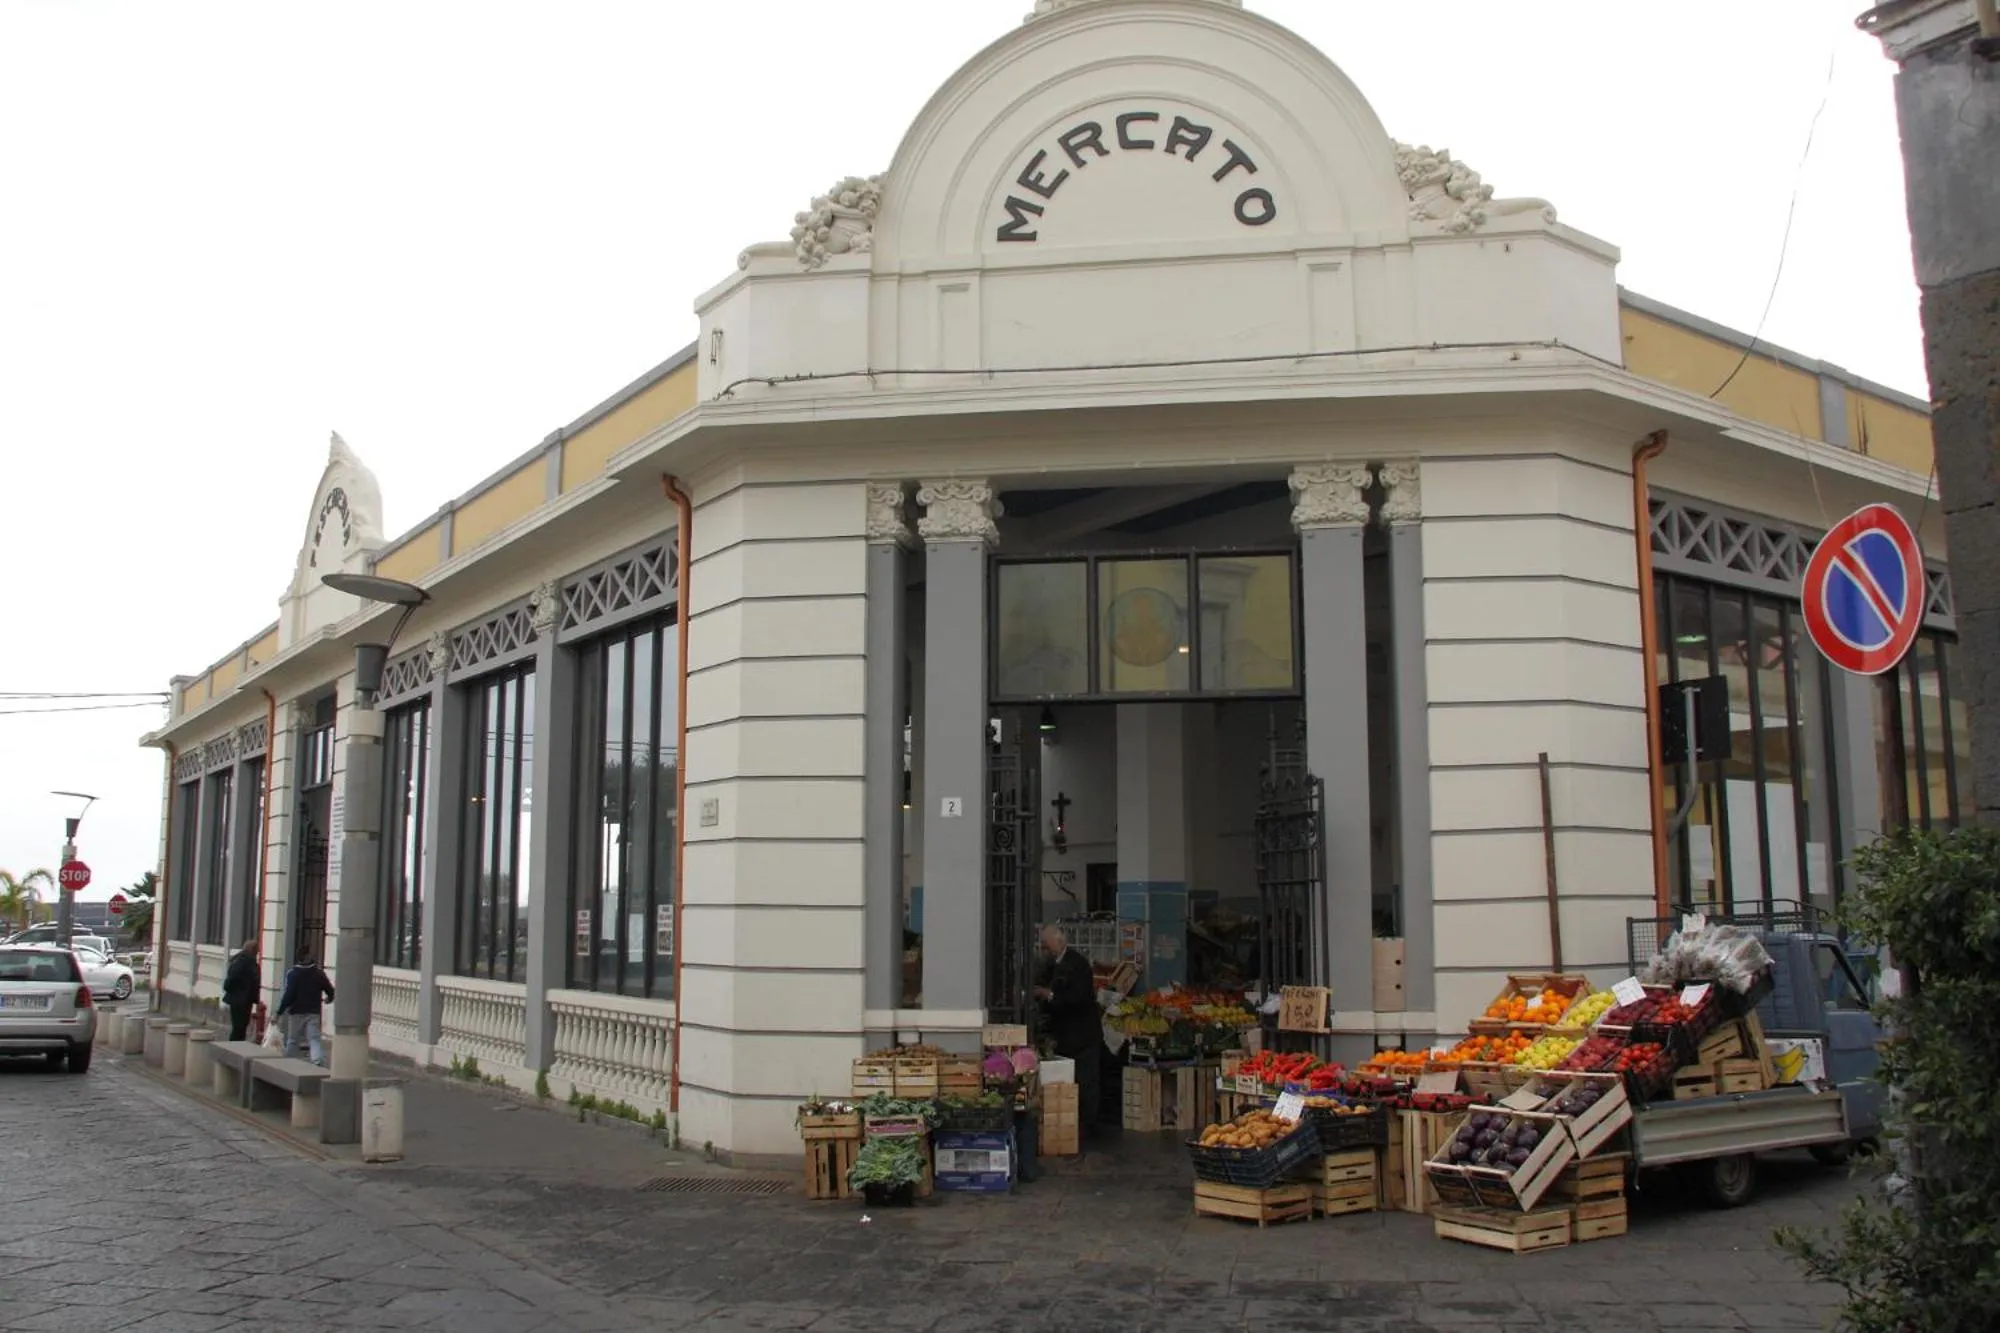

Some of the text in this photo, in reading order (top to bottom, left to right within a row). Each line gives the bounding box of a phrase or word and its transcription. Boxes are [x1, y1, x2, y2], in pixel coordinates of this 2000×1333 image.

[996, 111, 1277, 242] MERCATO
[948, 800, 955, 813] 2
[60, 870, 89, 882] STOP
